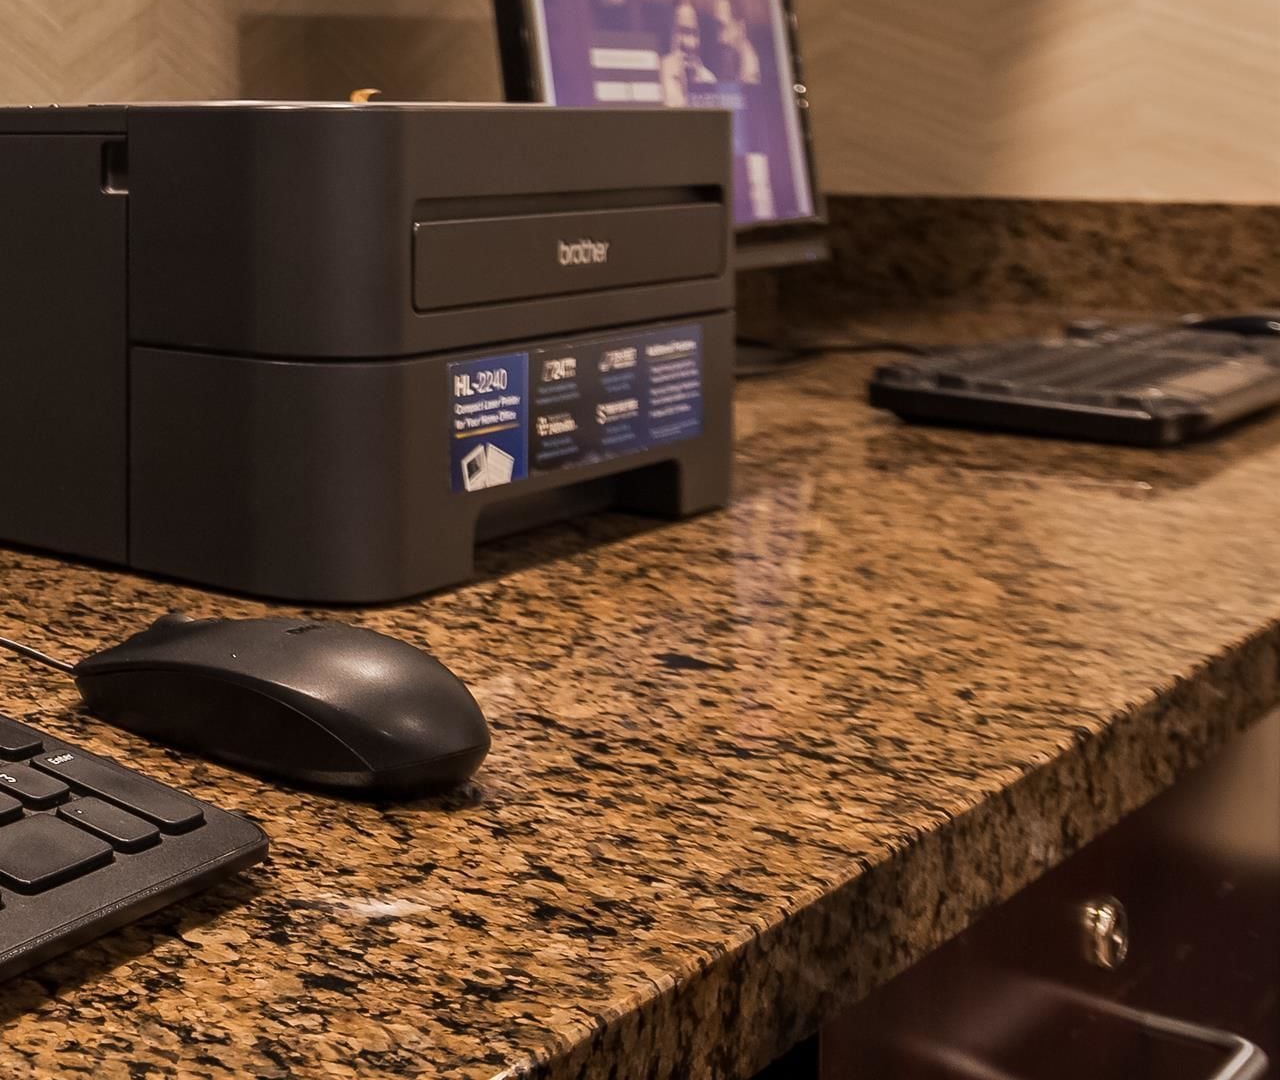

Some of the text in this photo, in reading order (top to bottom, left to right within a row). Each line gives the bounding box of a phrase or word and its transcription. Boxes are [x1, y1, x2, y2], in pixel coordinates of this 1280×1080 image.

[558, 239, 609, 266] brother
[454, 368, 508, 397] HL-2240
[47, 752, 74, 766] Enter
